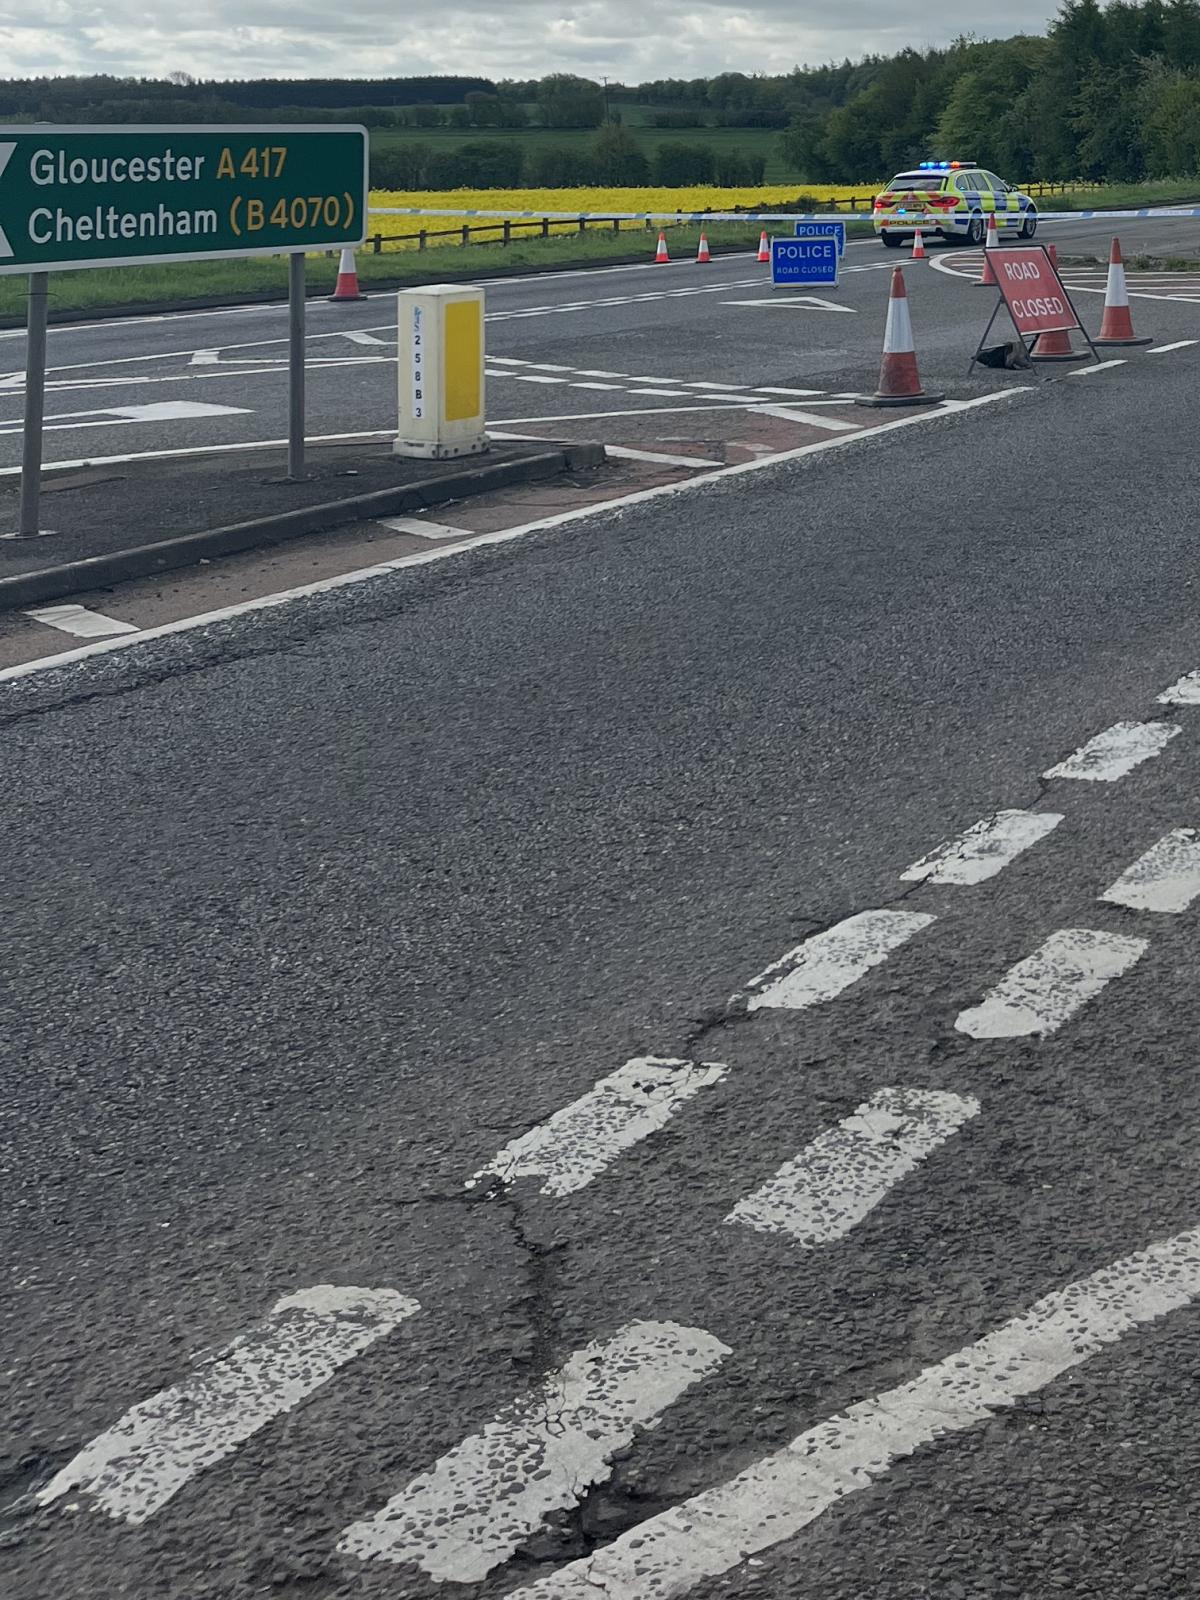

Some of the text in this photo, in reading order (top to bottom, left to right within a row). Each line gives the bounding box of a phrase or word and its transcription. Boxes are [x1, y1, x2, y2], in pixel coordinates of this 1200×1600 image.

[30, 147, 288, 186] Gloucester A417
[28, 203, 217, 244] Cheltenham
[799, 225, 841, 236] POLICE
[777, 245, 832, 259] POLICE
[776, 265, 834, 274] ROAD CLOSED
[1003, 262, 1040, 280] ROAD
[1012, 296, 1064, 318] CLOSED
